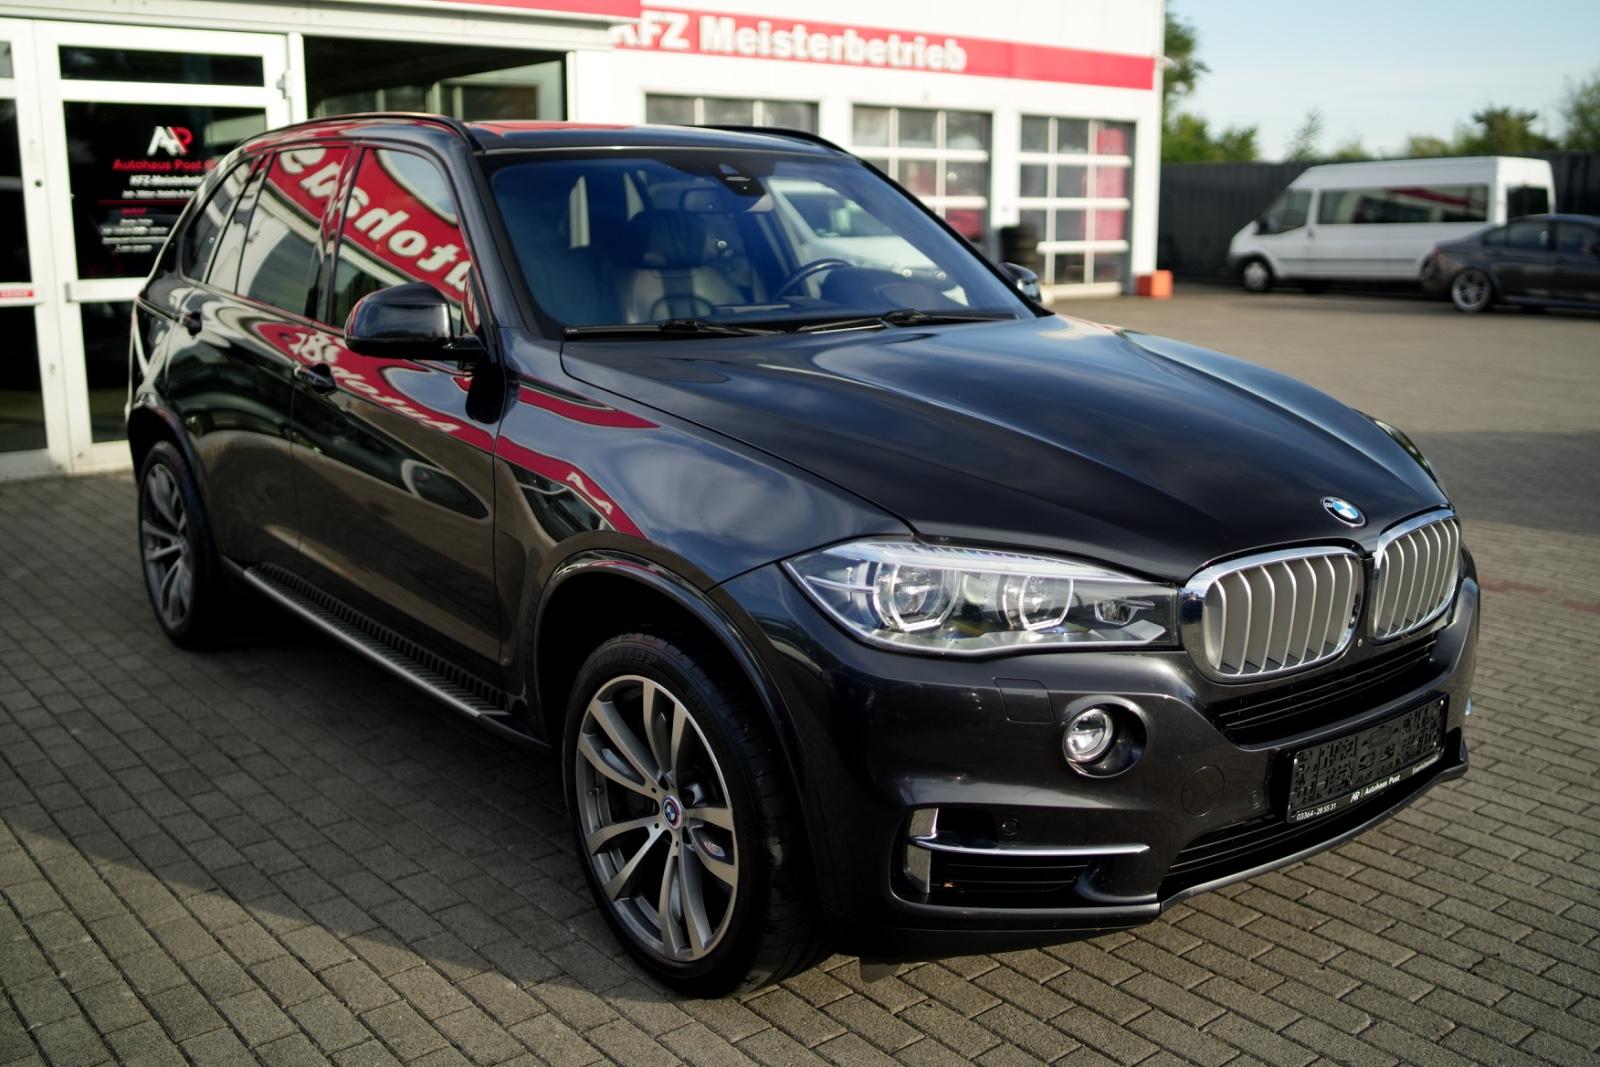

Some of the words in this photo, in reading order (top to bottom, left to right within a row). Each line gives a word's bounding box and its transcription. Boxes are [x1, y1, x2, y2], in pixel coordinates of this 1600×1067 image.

[700, 15, 967, 71] Meisterbetrieb
[112, 159, 172, 171] Autohaus
[174, 159, 202, 171] Post
[1364, 781, 1388, 796] Autohaus
[1388, 774, 1401, 785] Post
